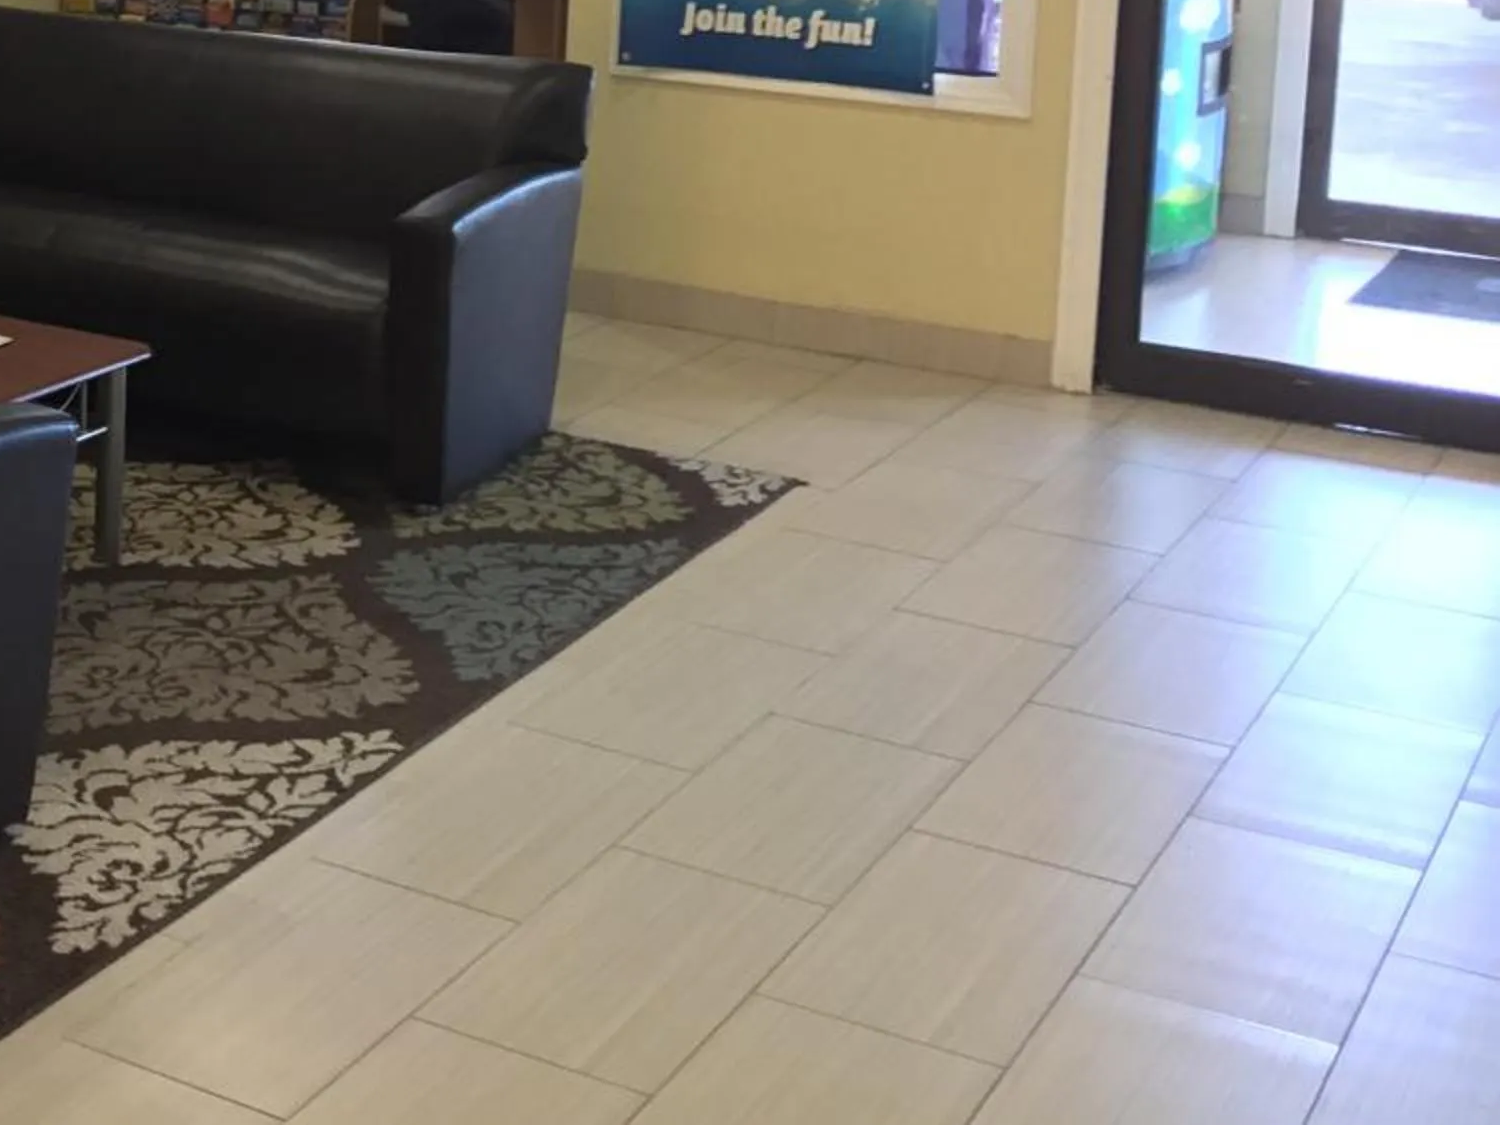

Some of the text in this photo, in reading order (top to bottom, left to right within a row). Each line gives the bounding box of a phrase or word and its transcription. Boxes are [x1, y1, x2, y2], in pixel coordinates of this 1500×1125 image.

[679, 1, 876, 50] Join the fun!
